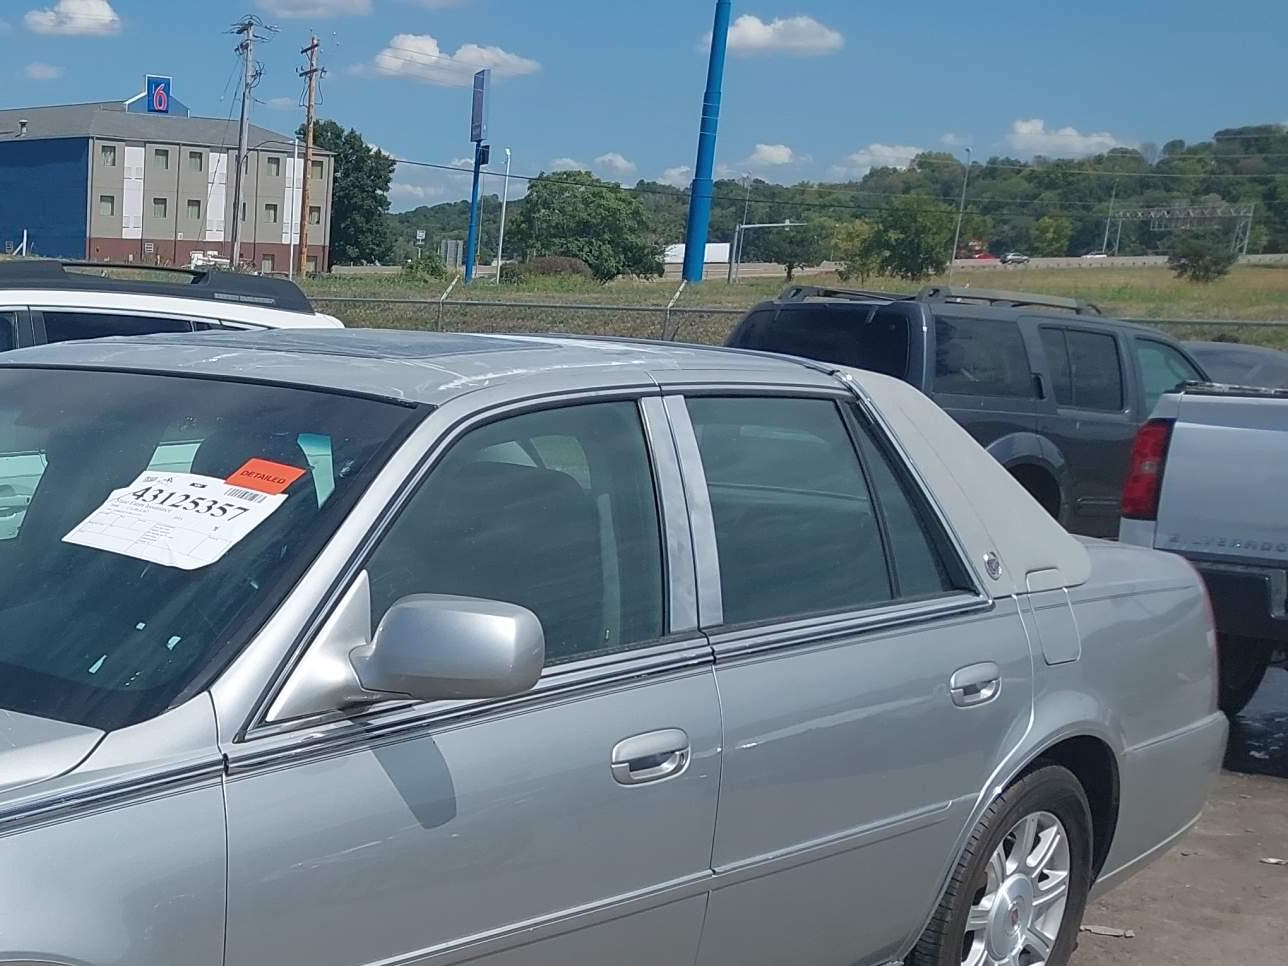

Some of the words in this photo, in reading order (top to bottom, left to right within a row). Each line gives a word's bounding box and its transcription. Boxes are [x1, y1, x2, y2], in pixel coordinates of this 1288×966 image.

[154, 83, 168, 111] 6
[240, 470, 286, 485] DETAILED
[133, 486, 250, 521] 43125357
